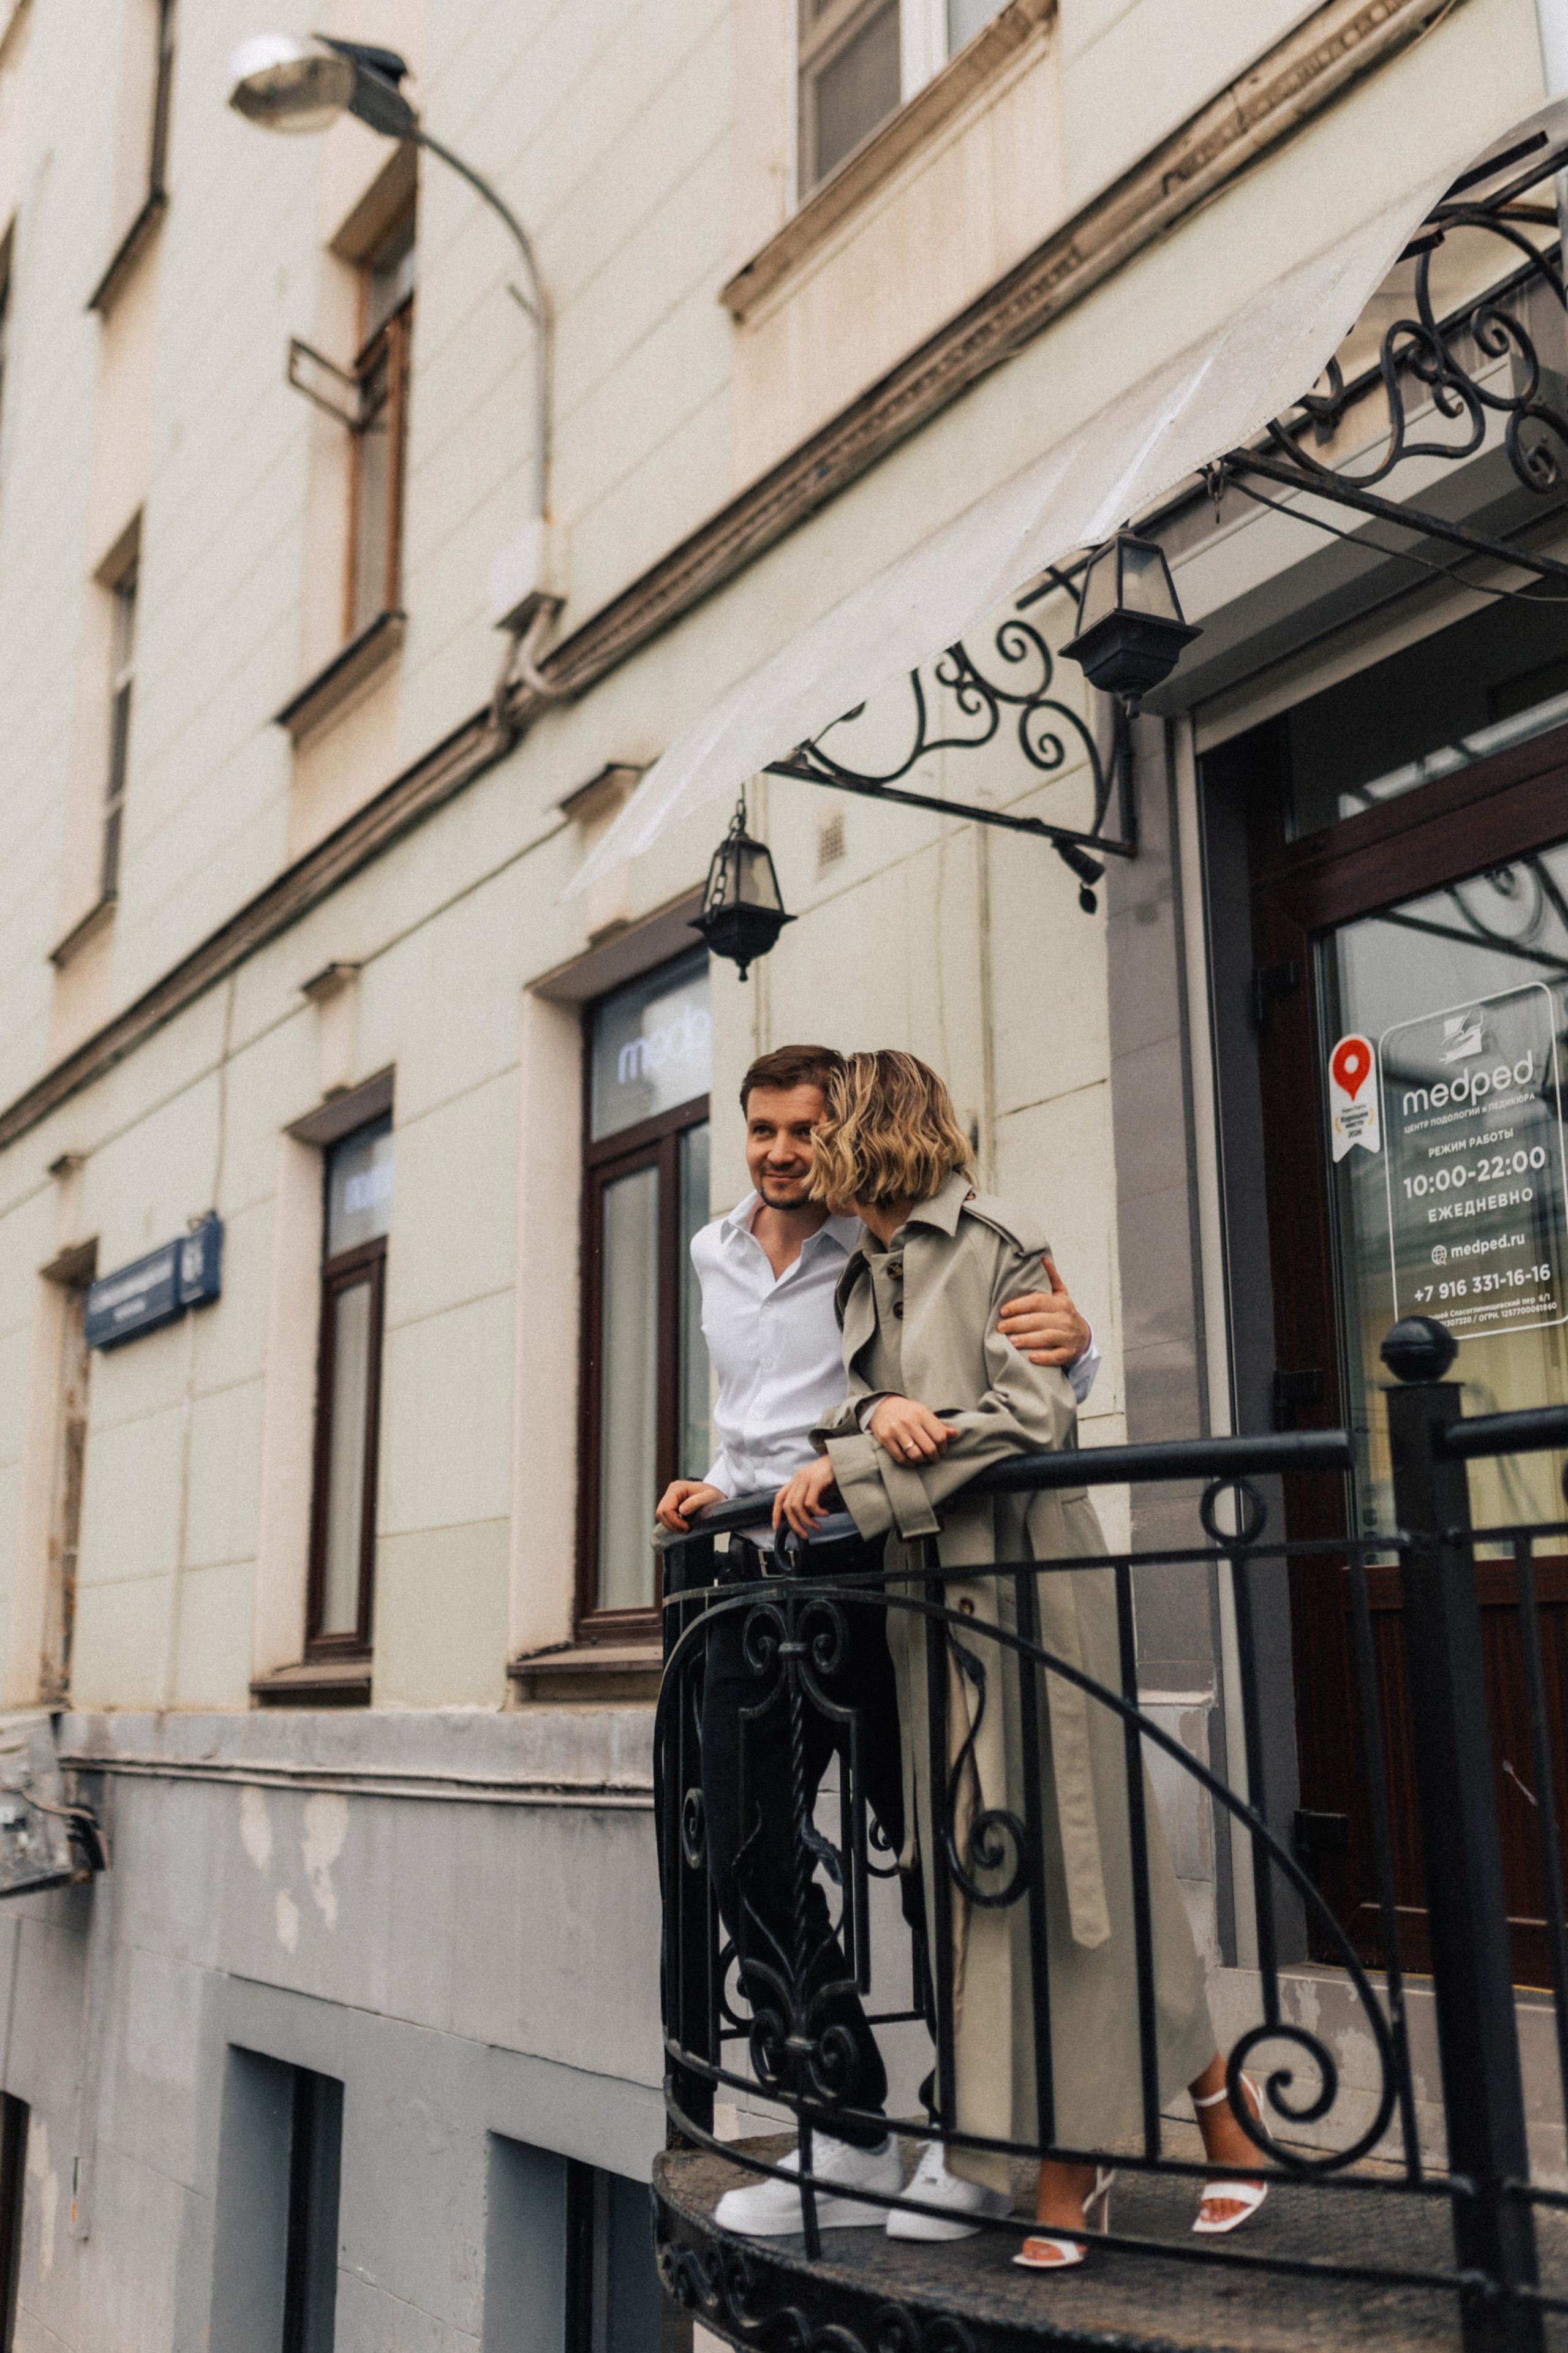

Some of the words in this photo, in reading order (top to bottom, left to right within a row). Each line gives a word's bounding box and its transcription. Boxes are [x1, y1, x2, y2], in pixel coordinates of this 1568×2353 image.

[618, 1005, 713, 1084] medp
[1403, 1049, 1533, 1116] medped
[1404, 1119, 1428, 1134] ЦЕНТР
[1430, 1106, 1480, 1127] ПОДОЛОГИИ
[1488, 1092, 1536, 1111] ПЕДИКЮРА
[1428, 1139, 1466, 1158] РЕЖИМ
[1469, 1127, 1513, 1147] РАБОТЫ
[1403, 1146, 1545, 1199] 10:00-22:00
[1428, 1187, 1533, 1223] ЕЖЕДНЕВНО
[1450, 1233, 1525, 1258] medped.ru
[1414, 1285, 1433, 1302] +7
[1439, 1279, 1467, 1299] 916
[1472, 1264, 1551, 1293] 331-16-16
[1539, 1293, 1550, 1302] 6/1
[1501, 1302, 1557, 1318] 1257700061860
